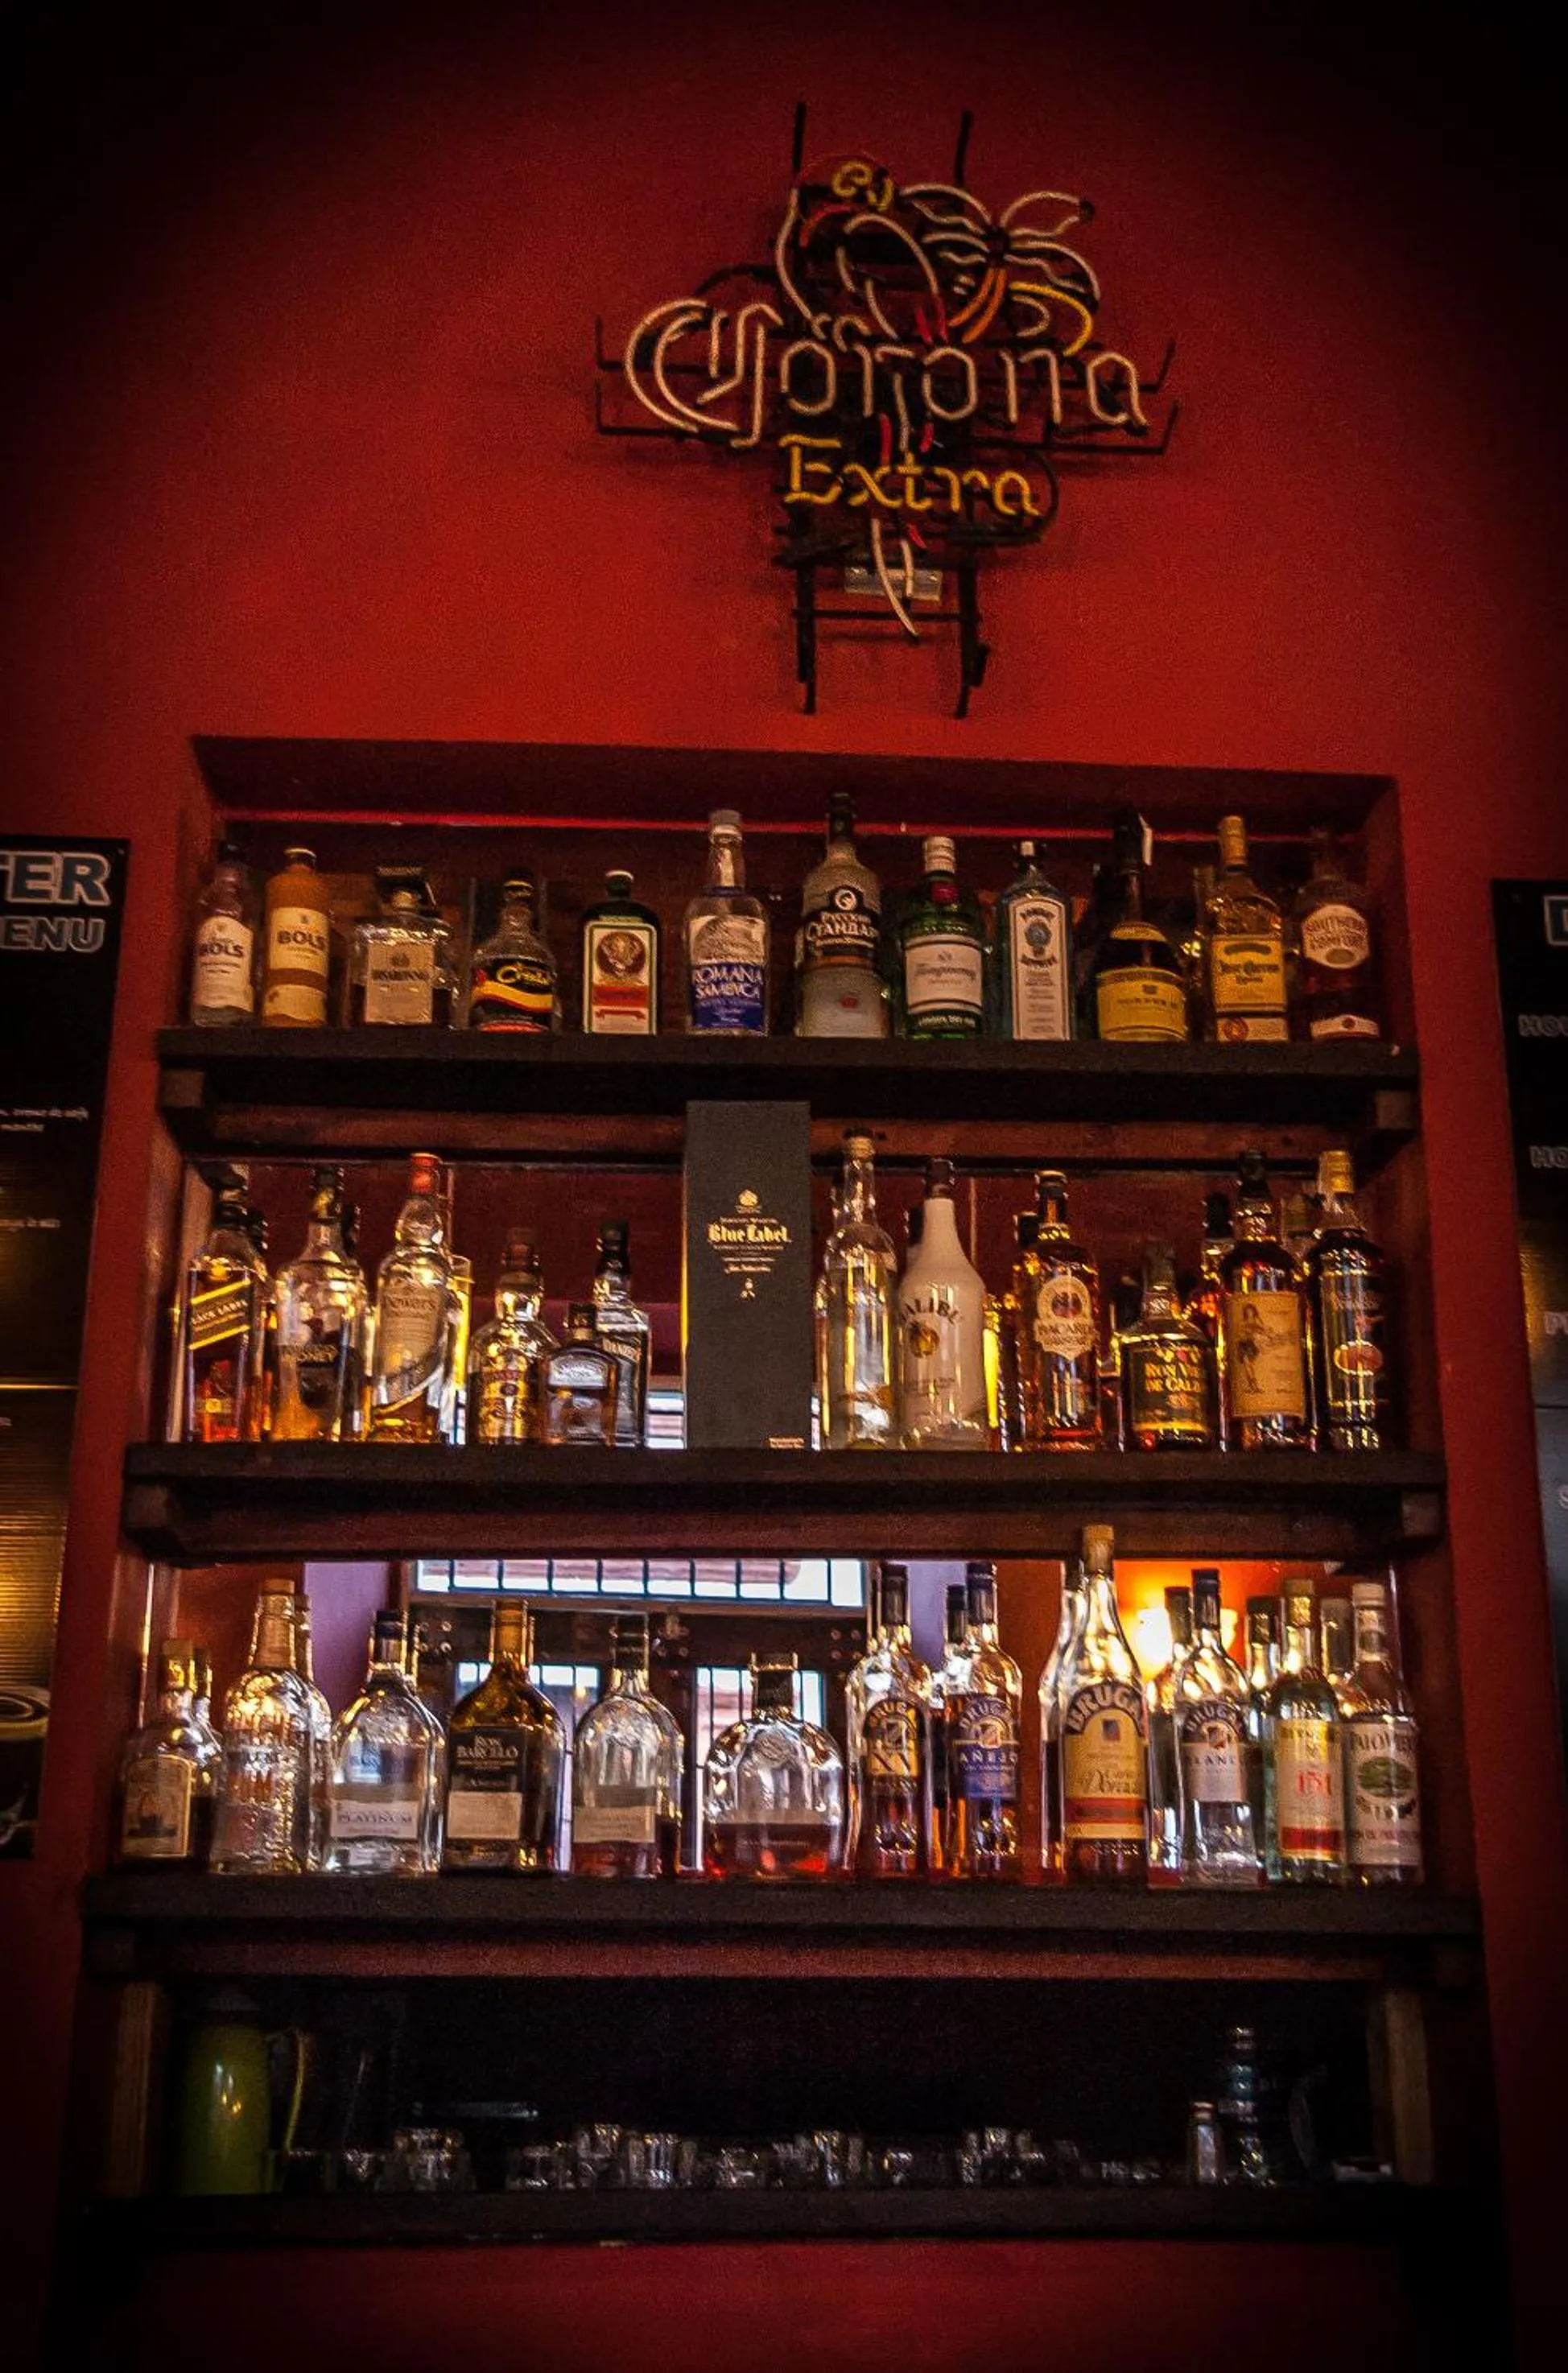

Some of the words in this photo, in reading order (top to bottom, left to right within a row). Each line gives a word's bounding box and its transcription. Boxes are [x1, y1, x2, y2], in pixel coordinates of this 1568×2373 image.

[625, 298, 1149, 448] Corona
[779, 434, 1042, 517] Extra
[0, 850, 111, 907] ER
[0, 914, 106, 953] ENU
[276, 930, 327, 951] BOLS
[199, 940, 245, 958] BOLS
[707, 1222, 745, 1243] Blue
[745, 1223, 790, 1243] Label
[337, 1813, 413, 1824] PLATINUM
